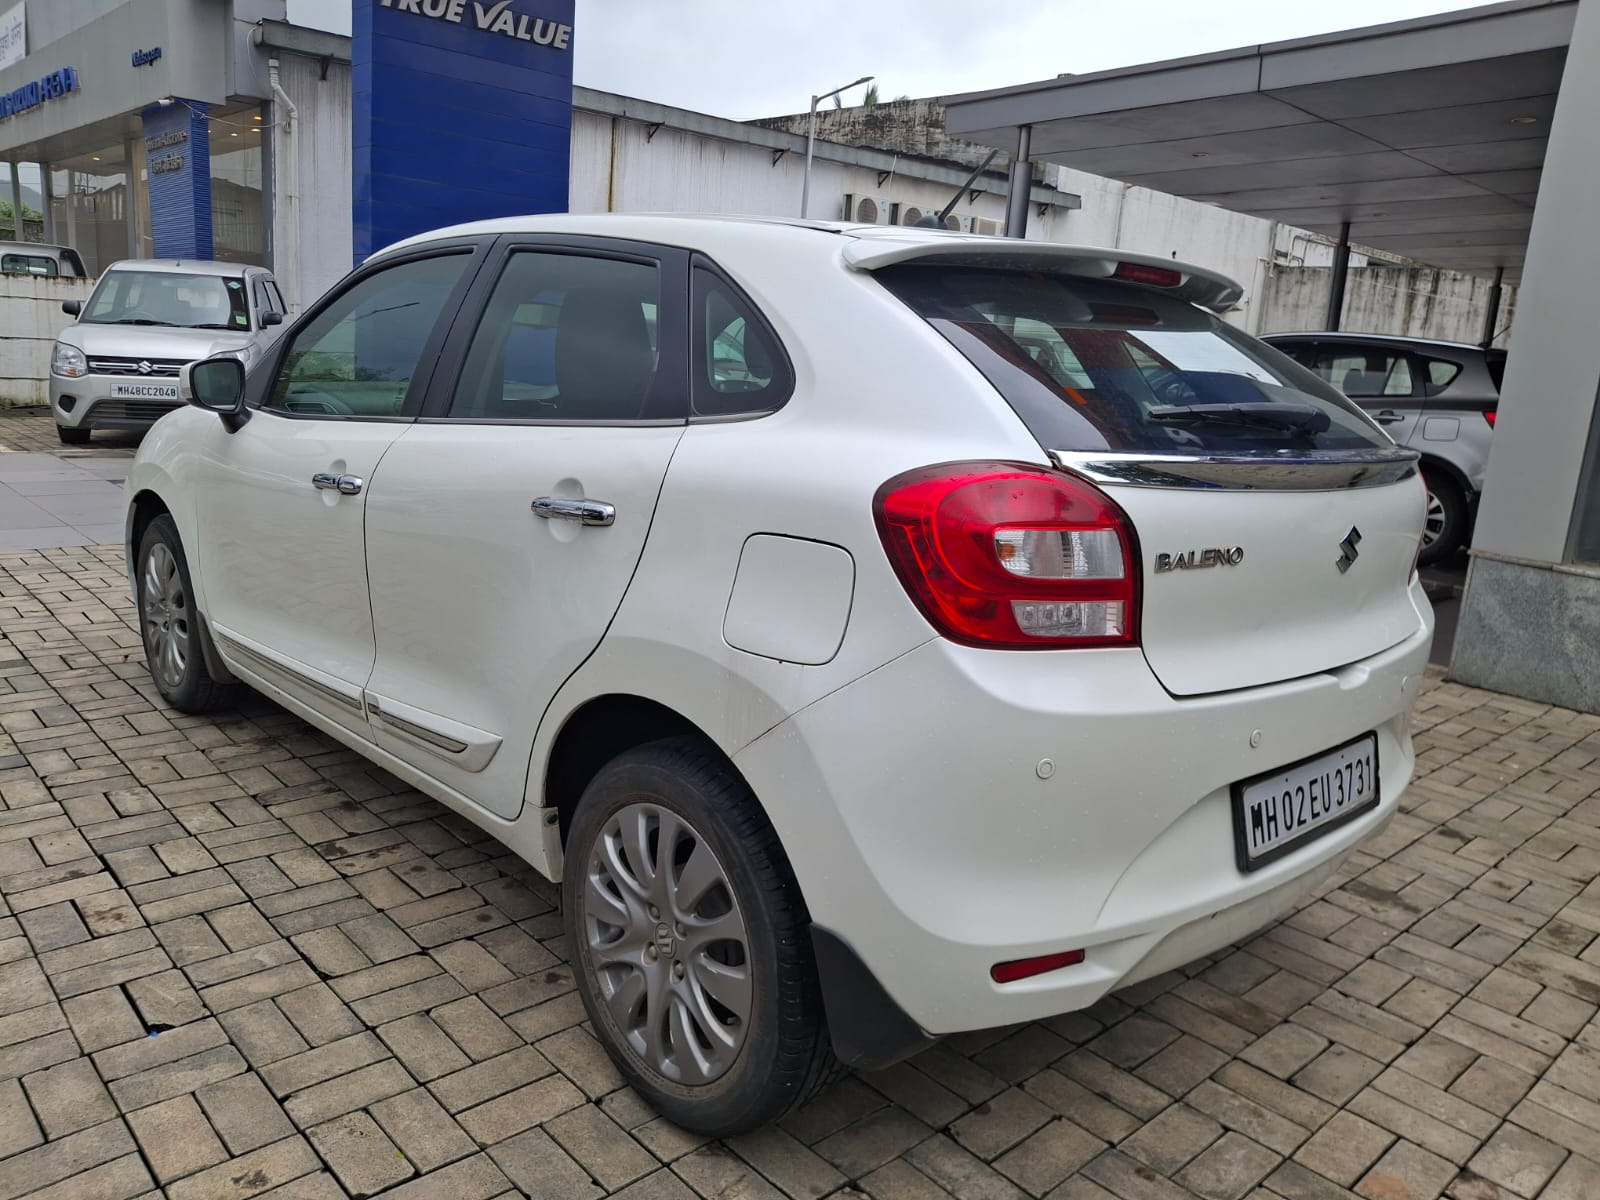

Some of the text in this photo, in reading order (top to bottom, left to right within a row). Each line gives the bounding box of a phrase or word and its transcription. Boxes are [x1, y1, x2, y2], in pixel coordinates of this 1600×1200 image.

[381, 0, 572, 49] RUE VALUE
[41, 66, 77, 102] ARENA
[117, 385, 176, 397] MH48CC2048
[1154, 546, 1244, 574] BALENO
